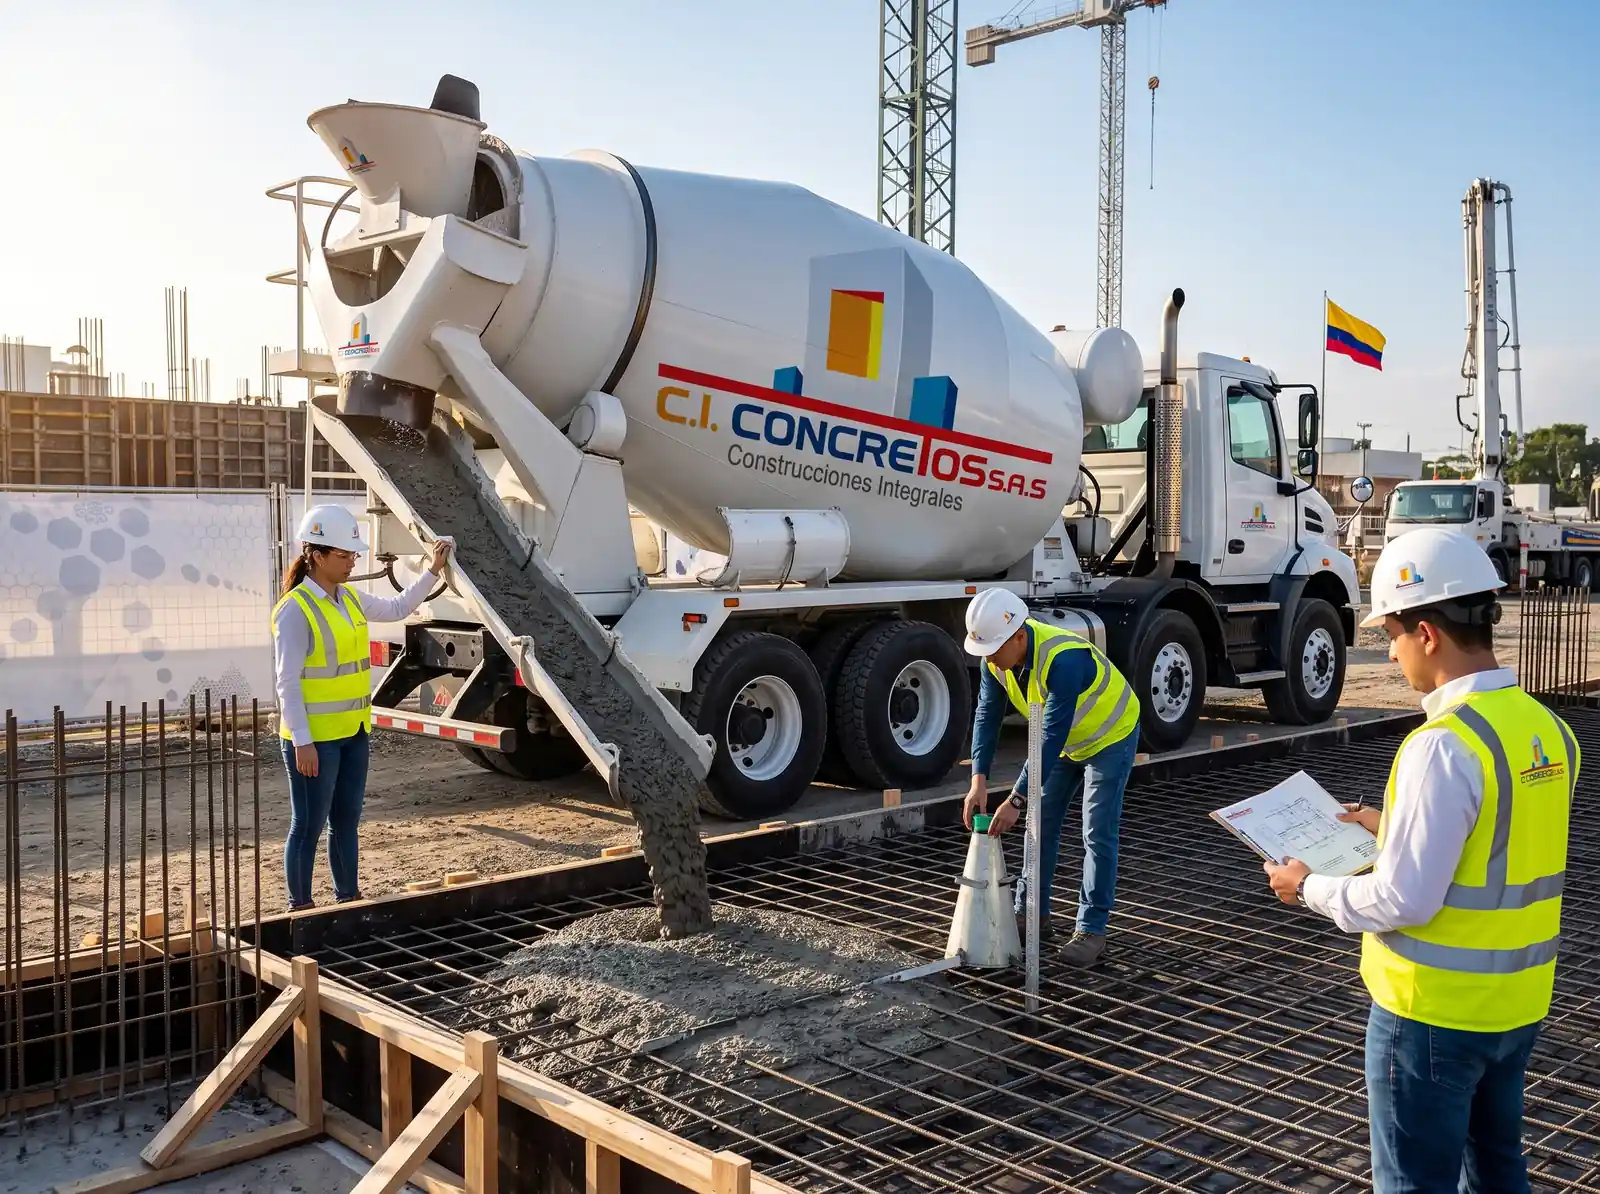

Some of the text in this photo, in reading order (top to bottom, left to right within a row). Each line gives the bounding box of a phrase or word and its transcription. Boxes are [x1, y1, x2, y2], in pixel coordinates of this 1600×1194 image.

[656, 385, 719, 432] C.I.
[731, 403, 988, 488] CONCRETOS
[727, 443, 963, 512] Construcciones Integrales
